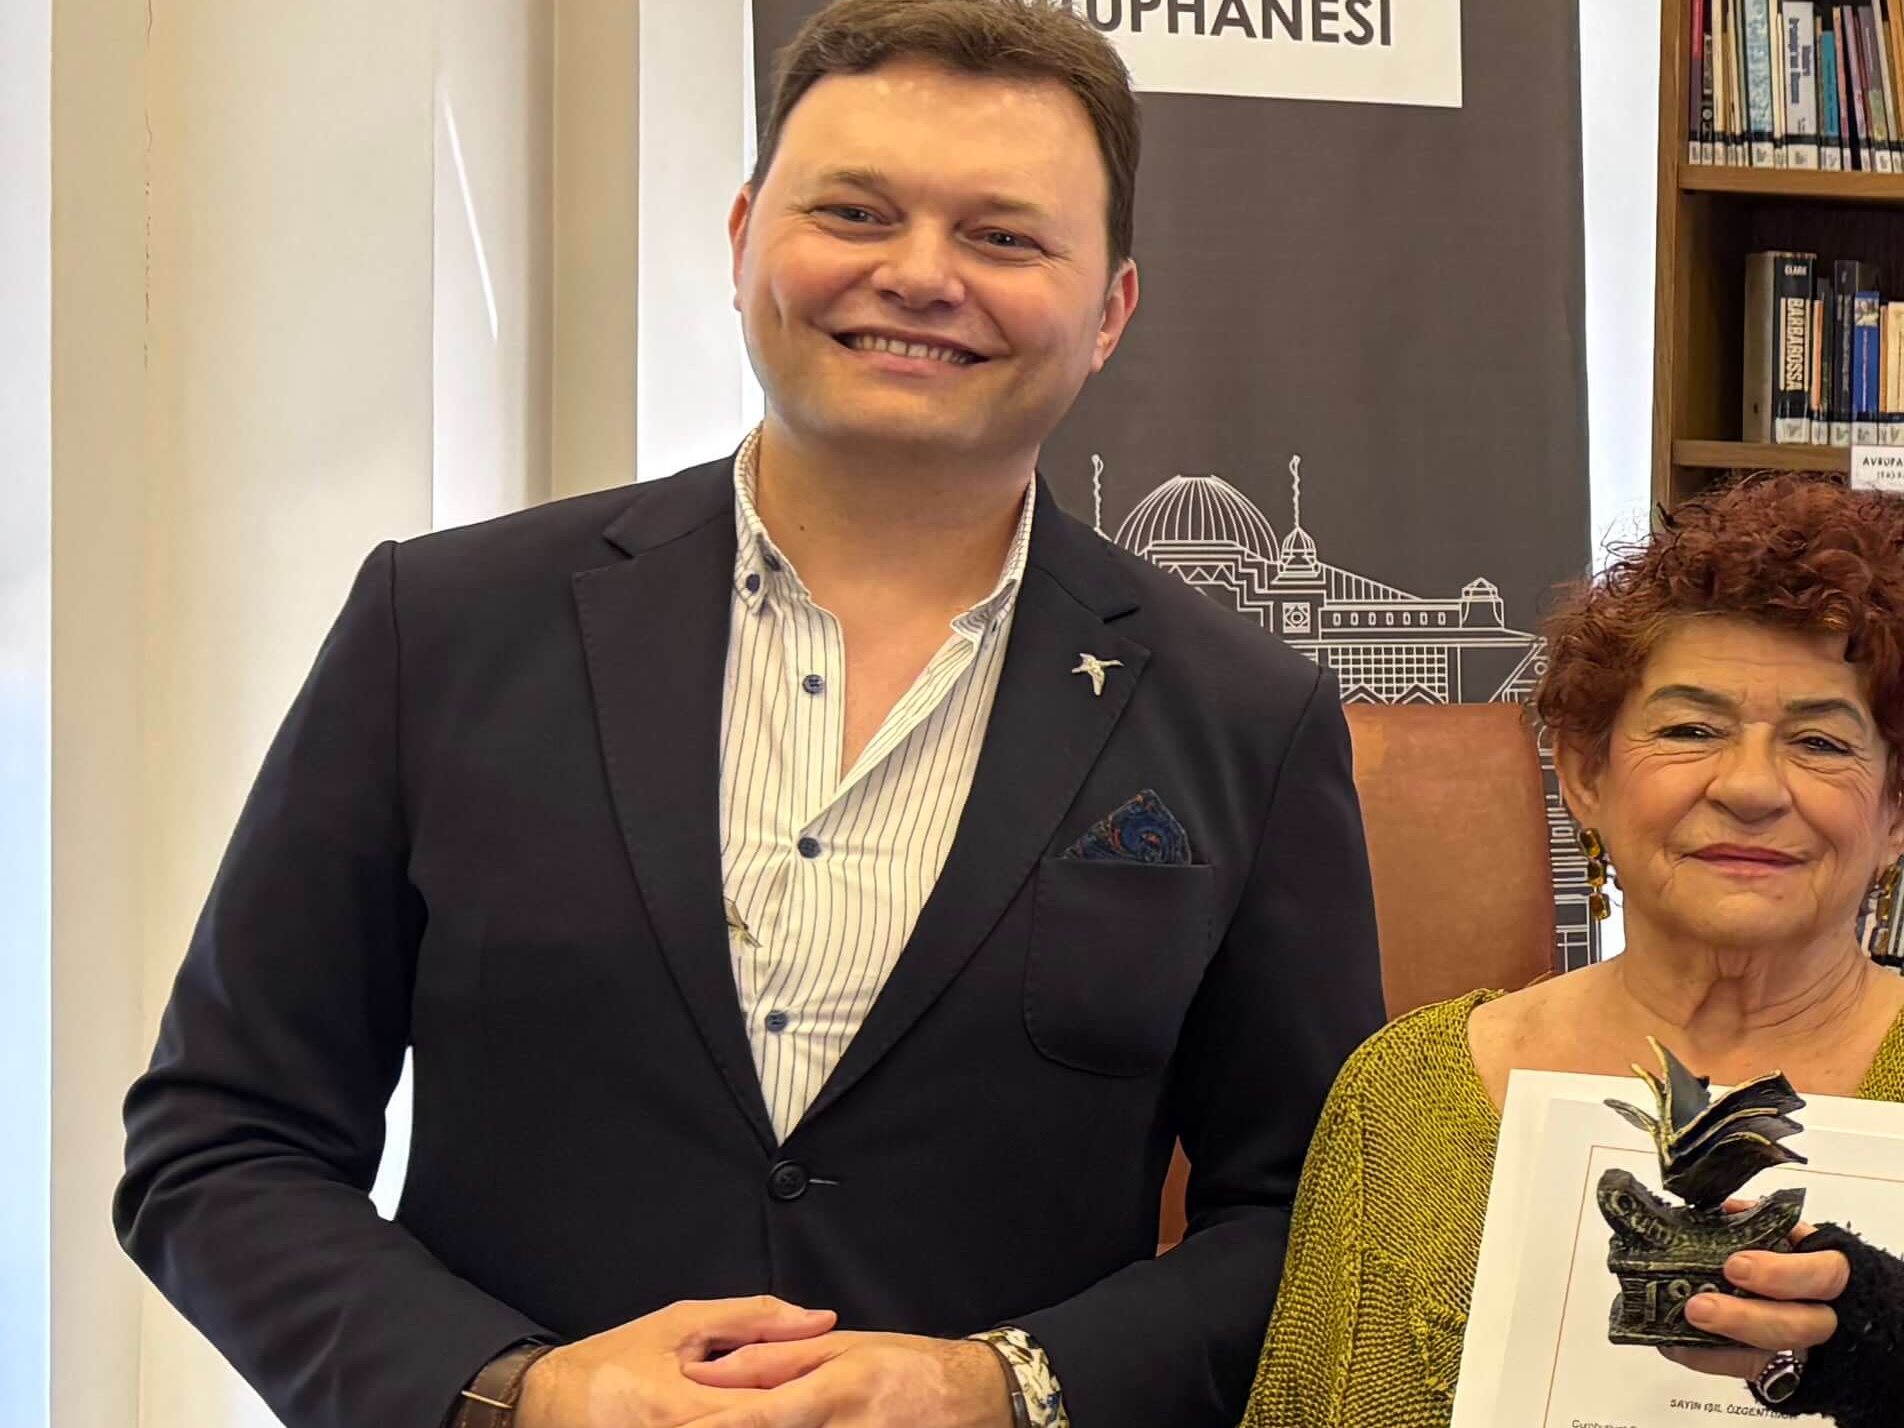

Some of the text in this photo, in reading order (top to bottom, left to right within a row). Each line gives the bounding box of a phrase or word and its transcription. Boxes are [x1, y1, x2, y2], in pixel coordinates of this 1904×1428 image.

[1786, 298, 1804, 392] BARBAROSSA
[1862, 456, 1903, 467] AVRUPA
[1670, 1398, 1701, 1411] SAYIN
